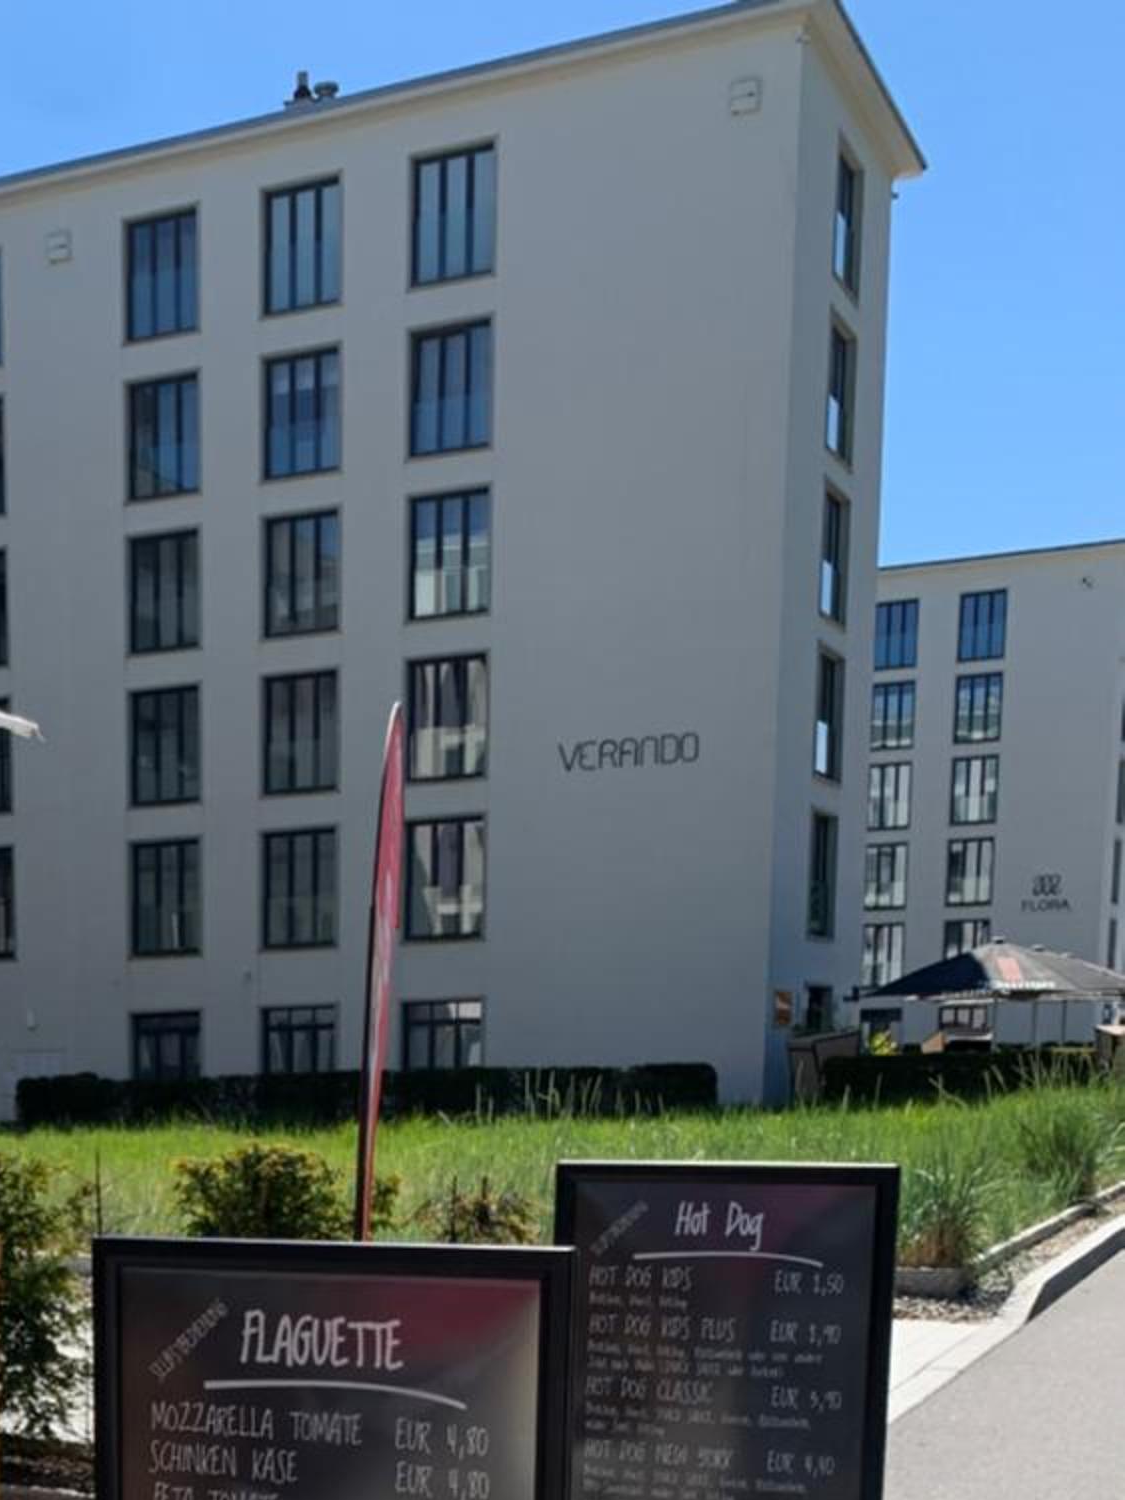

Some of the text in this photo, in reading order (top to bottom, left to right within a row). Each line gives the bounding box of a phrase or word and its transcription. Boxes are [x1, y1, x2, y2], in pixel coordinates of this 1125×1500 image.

[557, 732, 700, 772] VERANDO
[674, 1200, 711, 1237] Hot
[725, 1201, 765, 1251] Dog
[588, 1264, 620, 1288] HOT
[625, 1265, 652, 1289] DOG
[774, 1269, 803, 1294] EUR
[812, 1272, 845, 1295] 1,50
[239, 1308, 405, 1373] FLAGUETTE
[588, 1313, 620, 1335] HOT
[624, 1314, 652, 1338] DOG
[700, 1317, 736, 1343] PLUS
[769, 1319, 800, 1345] EUR
[656, 1379, 715, 1405] CLASSIC
[770, 1385, 800, 1411] EUR
[150, 1401, 490, 1461] MOZZARELLA TOMATE EUR 4,80
[147, 1439, 238, 1478] SCHINKEN
[394, 1460, 433, 1499] EUR
[767, 1449, 796, 1474] EUR
